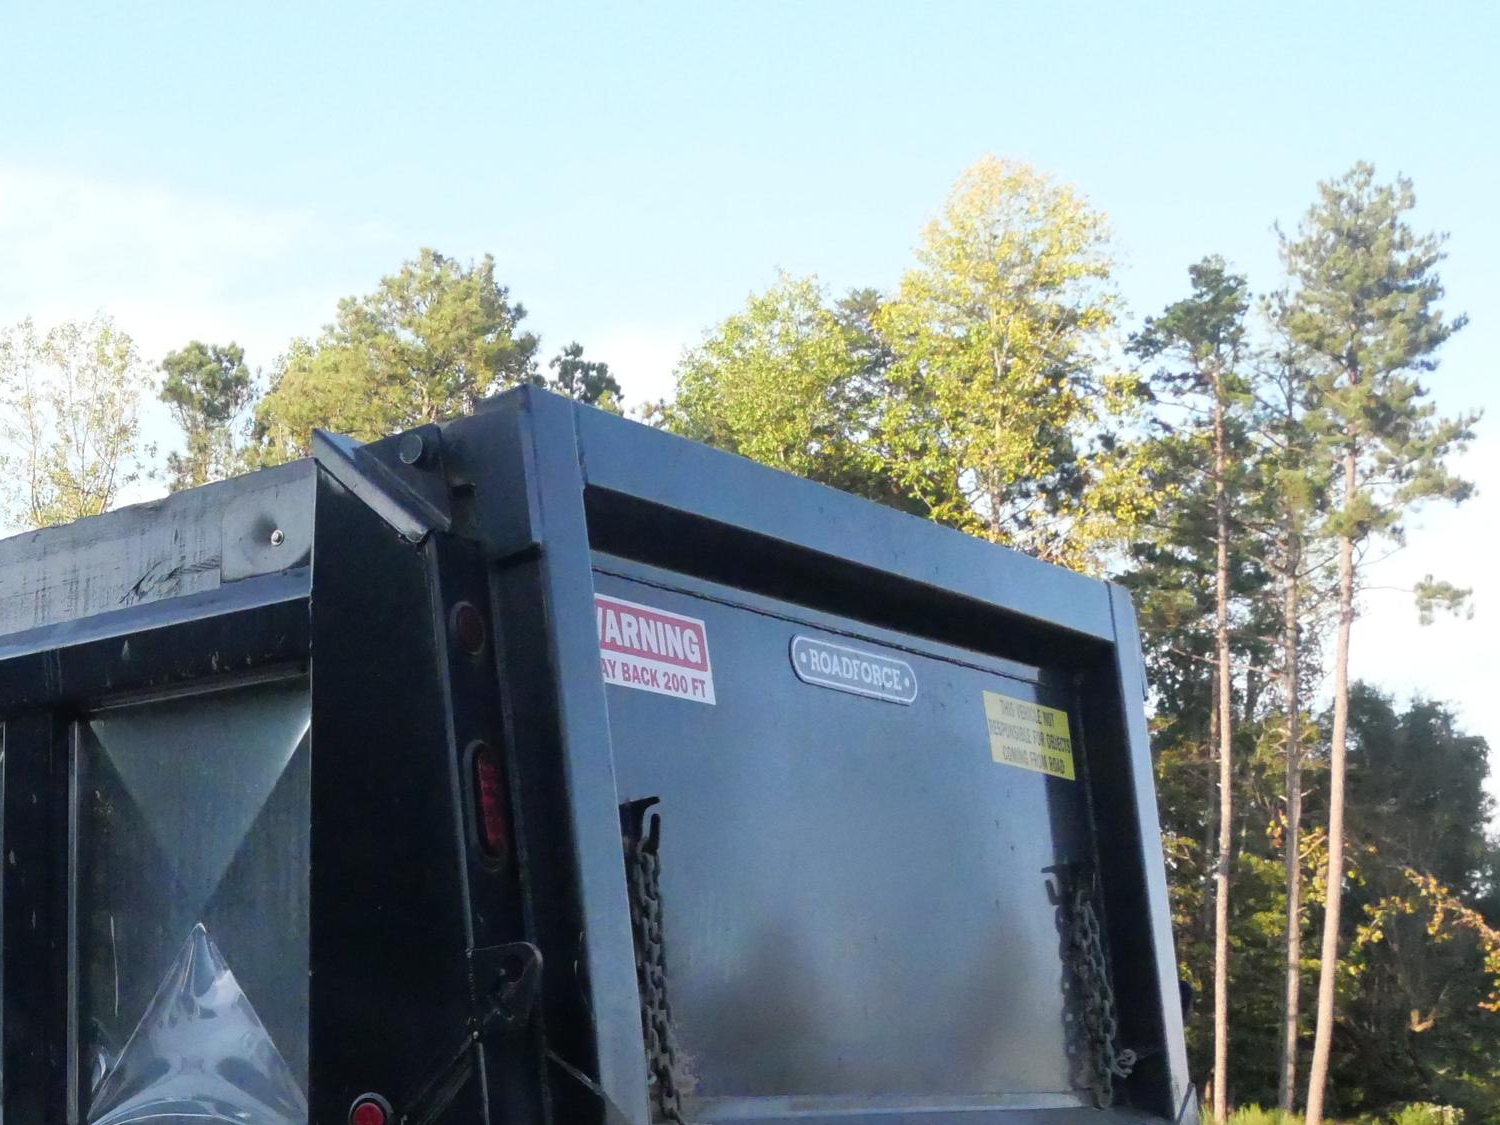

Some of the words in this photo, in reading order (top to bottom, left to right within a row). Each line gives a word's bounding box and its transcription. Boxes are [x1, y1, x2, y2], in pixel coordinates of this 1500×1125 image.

[600, 657, 616, 679] AY
[621, 662, 660, 689] BACK
[663, 672, 688, 694] 200
[691, 677, 706, 698] FT
[808, 648, 902, 691] ROADFORCE
[1016, 704, 1042, 725] VEHICLE
[1043, 711, 1055, 728] NOT
[1046, 733, 1071, 754] OBJECTS
[1048, 756, 1065, 775] ROAD
